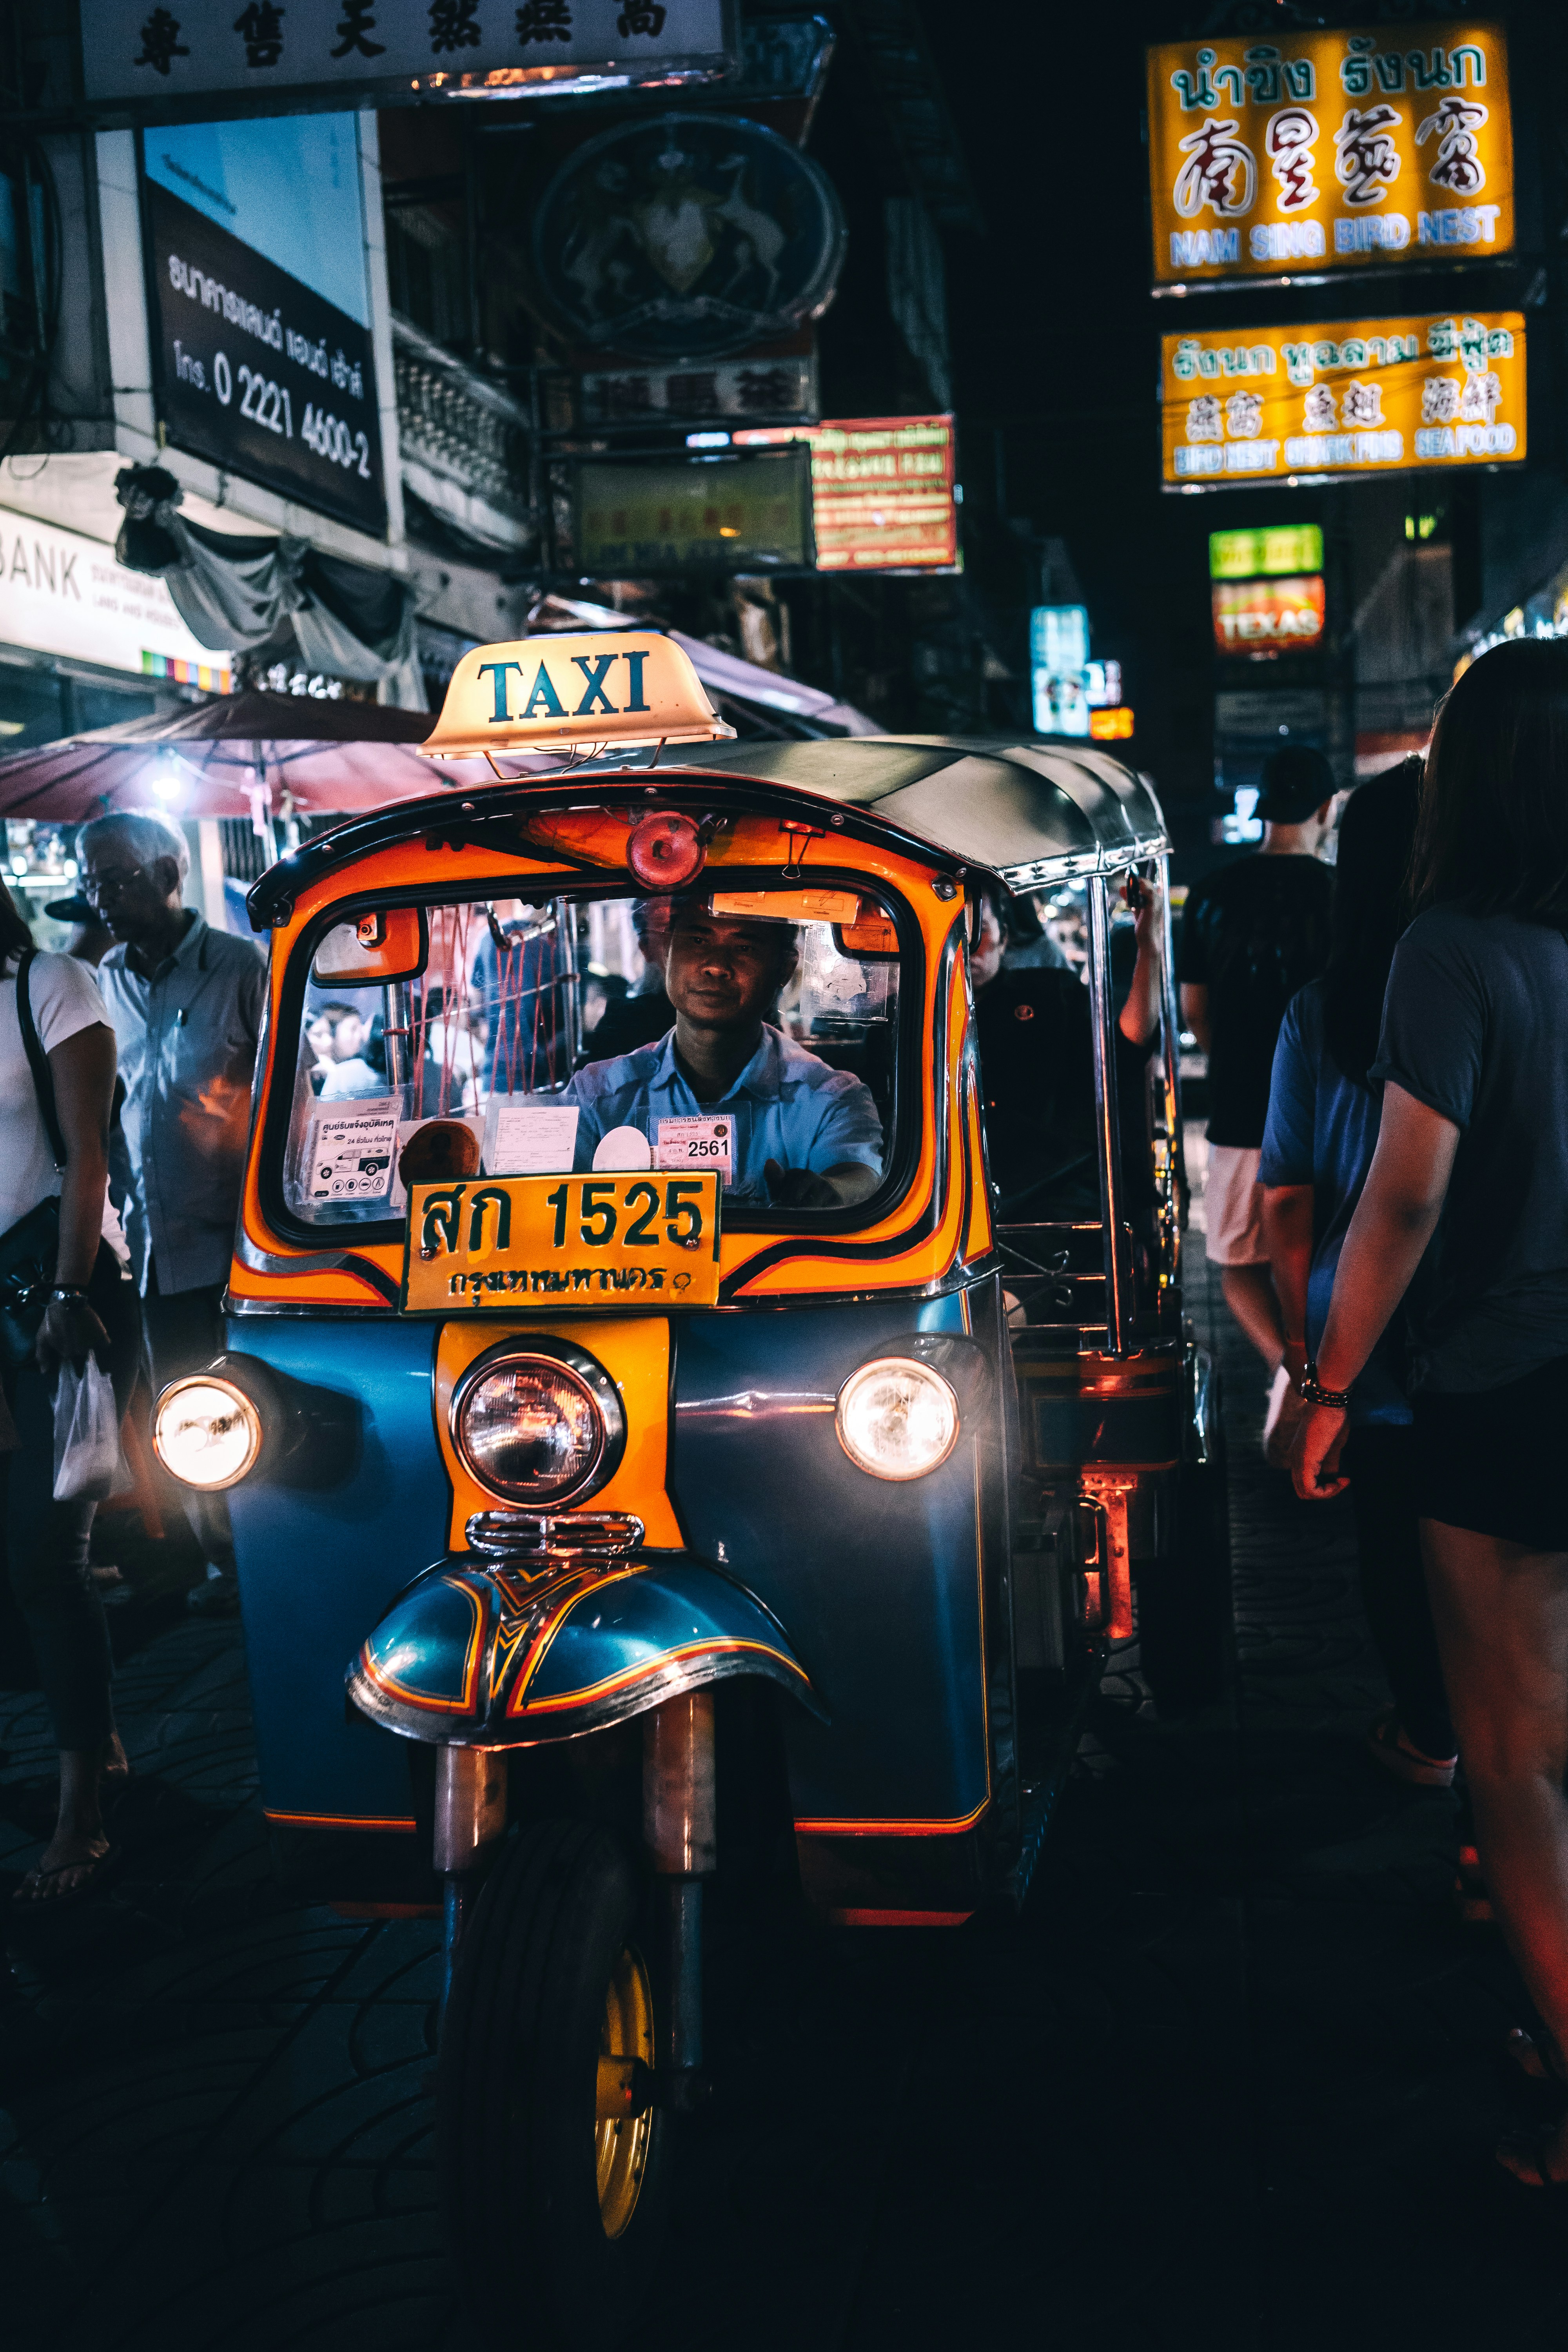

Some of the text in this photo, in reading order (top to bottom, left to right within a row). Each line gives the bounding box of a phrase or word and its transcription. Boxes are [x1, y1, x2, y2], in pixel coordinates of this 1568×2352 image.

[1170, 204, 1501, 267] NAM SING BIRD NEST
[214, 351, 233, 406] 0
[238, 364, 294, 439] 2221
[301, 402, 372, 480] 4600-2
[1174, 445, 1224, 476] BIRD
[1225, 439, 1280, 473] NEST
[1285, 433, 1356, 468] SHARK
[1356, 430, 1404, 463] FINS
[1219, 608, 1319, 641] TEXAS
[477, 651, 651, 722] TAXI
[660, 1113, 730, 1124] กรมการขนส่งทางบก
[688, 1139, 728, 1157] 2561
[421, 1181, 704, 1253] สก 1525
[449, 1267, 667, 1306] กรุงเทพมหานคร
